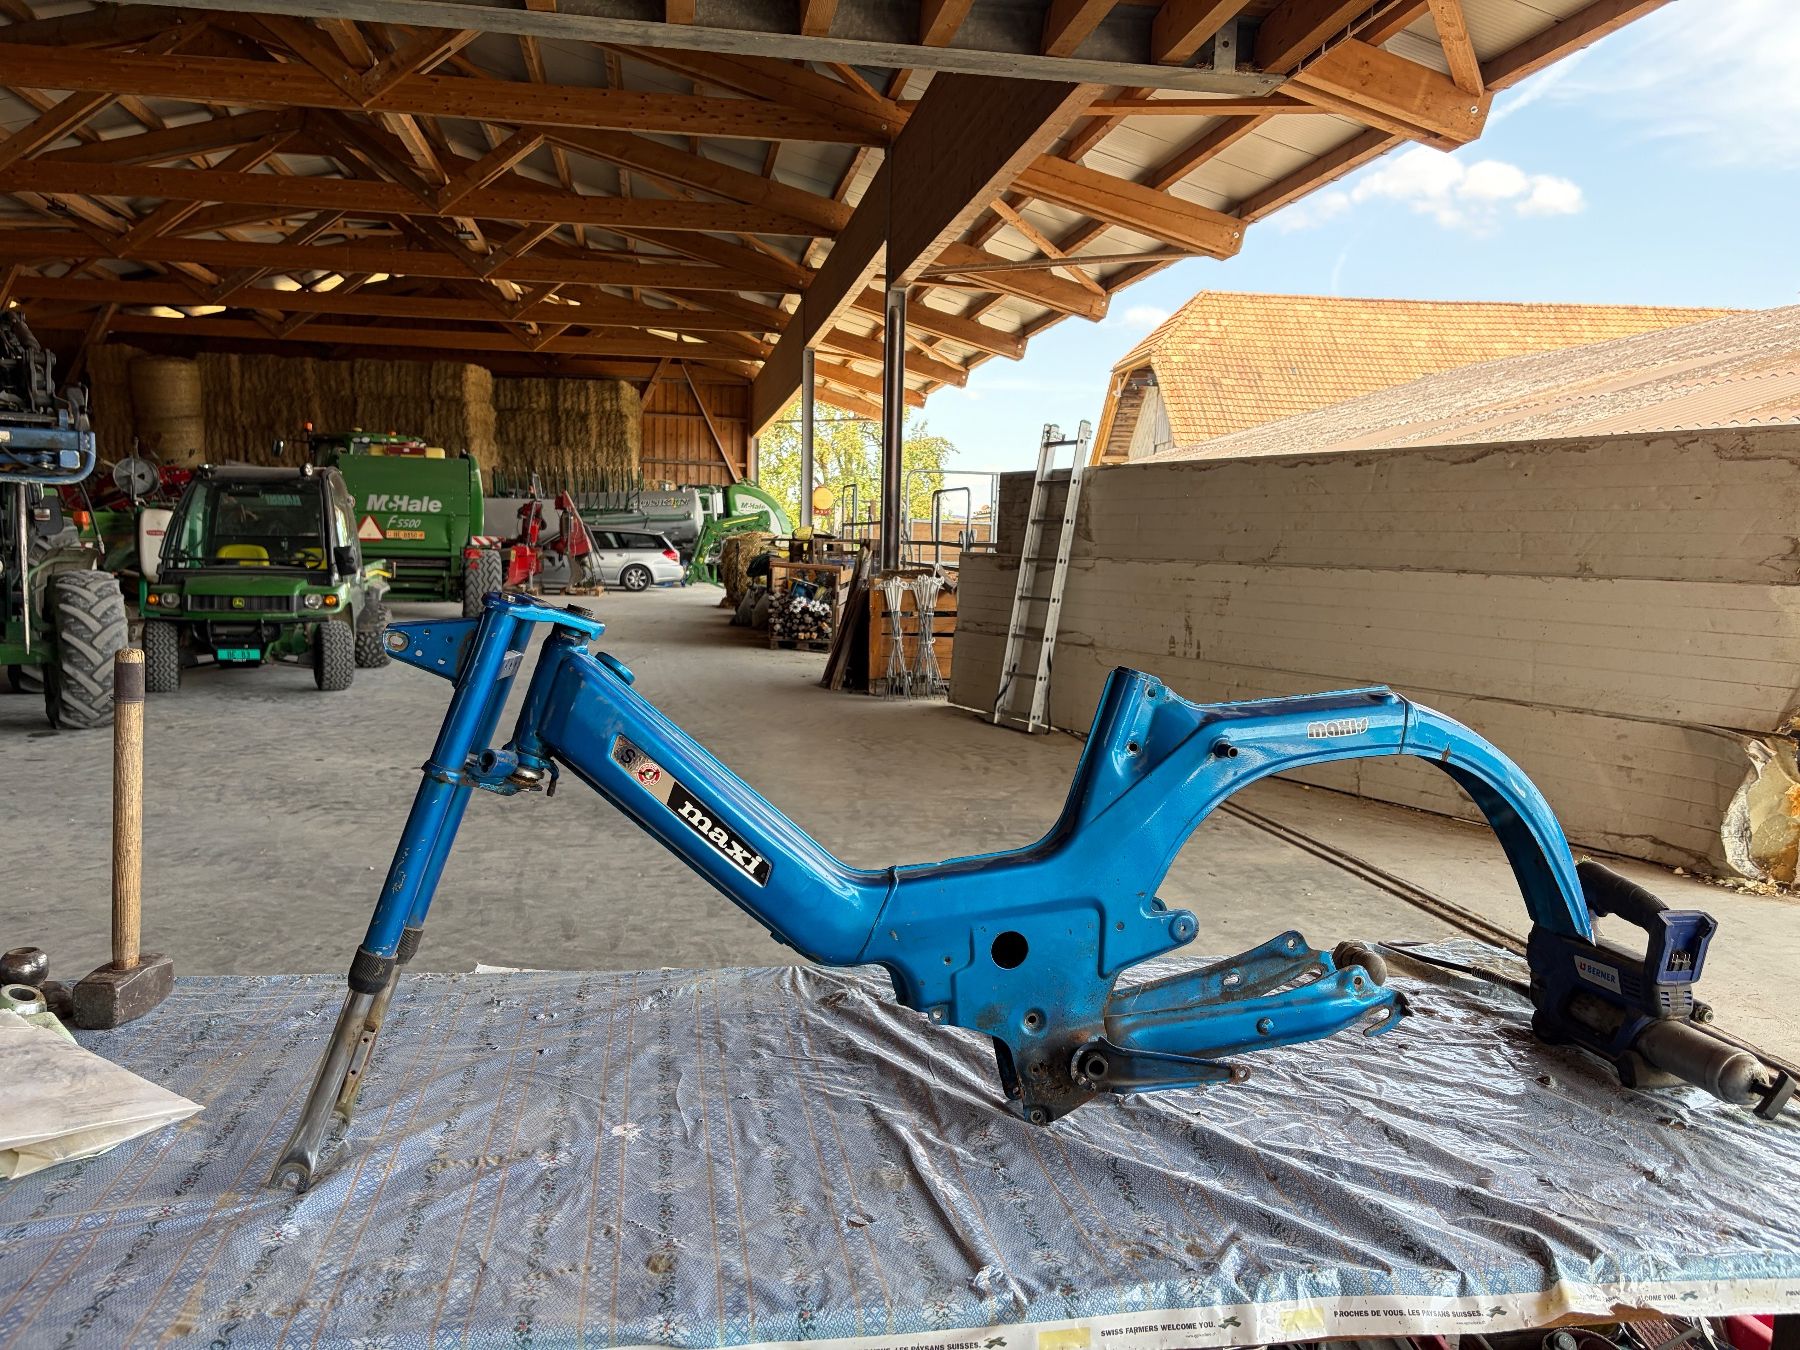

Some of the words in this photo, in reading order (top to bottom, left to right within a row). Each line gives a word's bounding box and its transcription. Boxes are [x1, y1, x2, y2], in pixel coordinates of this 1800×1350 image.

[366, 494, 442, 513] McHale
[677, 800, 763, 875] maxi
[1587, 964, 1616, 984] BERNER
[1333, 1310, 1369, 1318] PROCHES
[1383, 1309, 1406, 1317] VOUS.
[1408, 1308, 1421, 1316] LES
[1421, 1309, 1451, 1318] PAYSANS
[1451, 1310, 1484, 1318] SUISSES.
[1101, 1328, 1124, 1337] SWISS
[1125, 1325, 1159, 1336] FARMERS
[1160, 1322, 1198, 1332] WELCOME
[1199, 1321, 1216, 1330] YOU.
